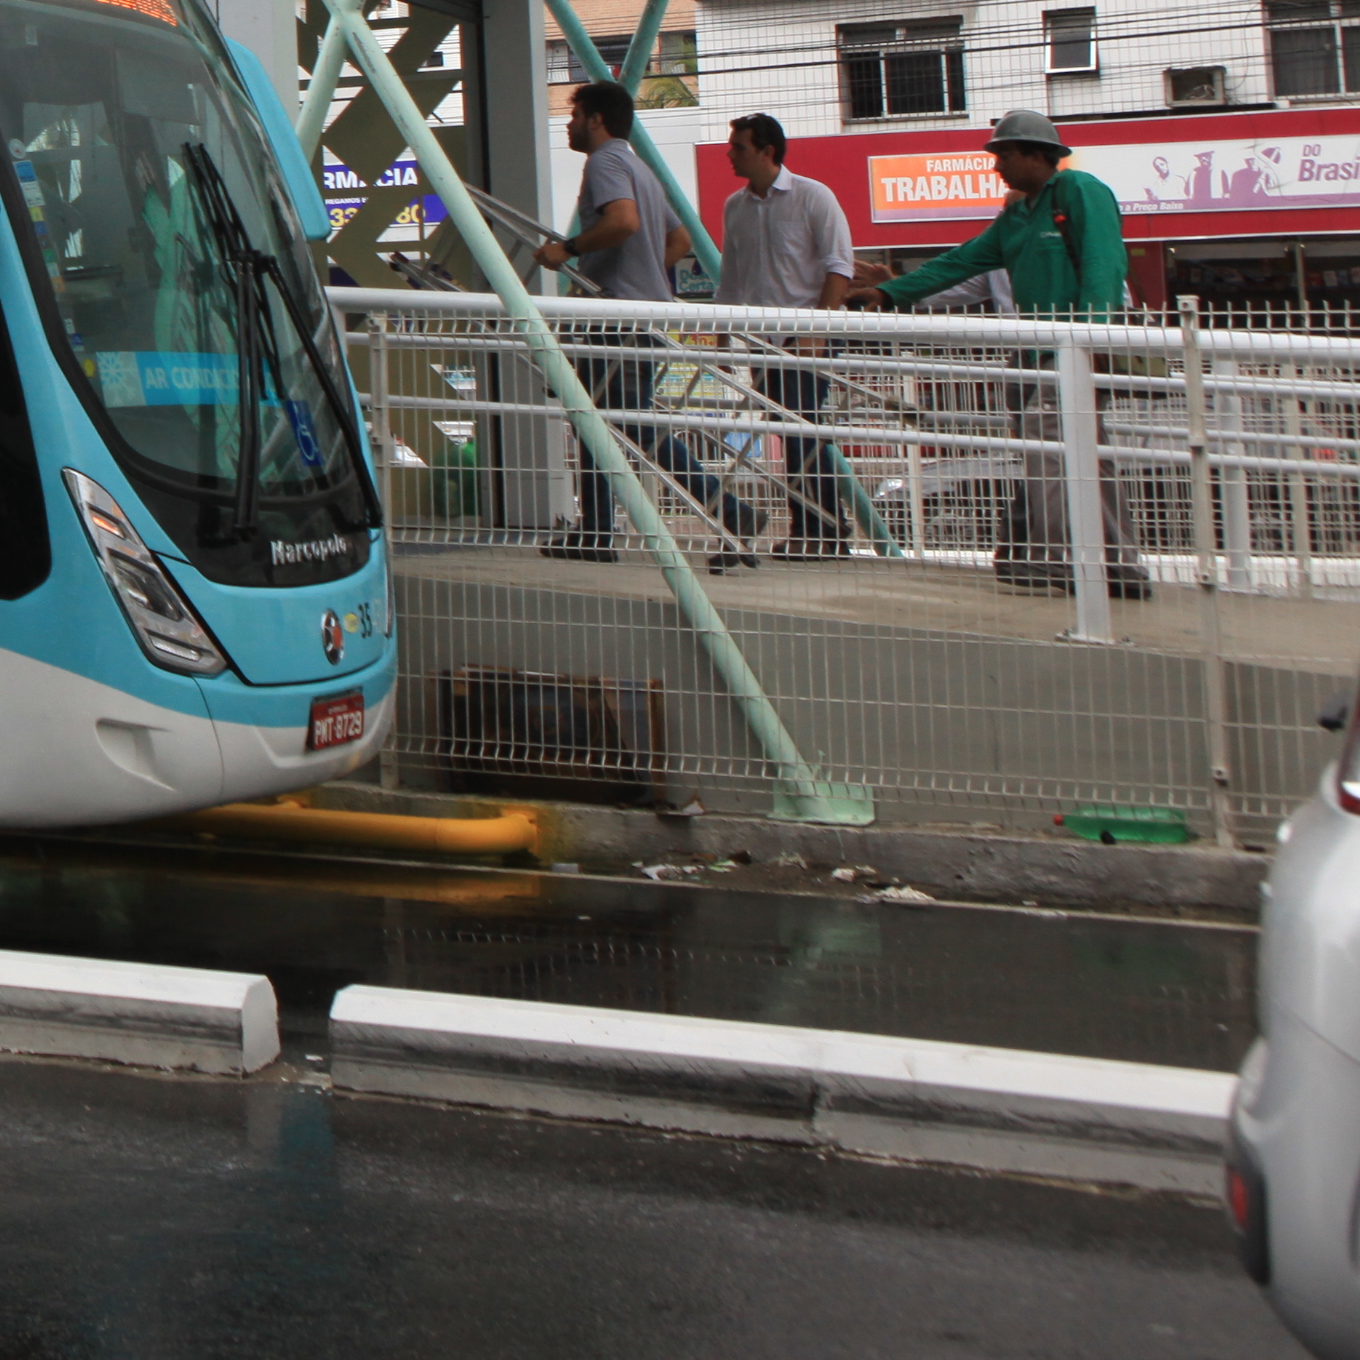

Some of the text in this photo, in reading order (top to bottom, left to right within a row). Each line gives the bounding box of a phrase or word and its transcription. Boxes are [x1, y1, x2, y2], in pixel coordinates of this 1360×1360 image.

[1302, 144, 1321, 157] DO
[926, 155, 996, 173] FARMÁCIA
[1297, 158, 1360, 182] Brasi
[1133, 202, 1158, 211] Preço
[1160, 201, 1184, 211] Baixo
[145, 367, 170, 389] AR
